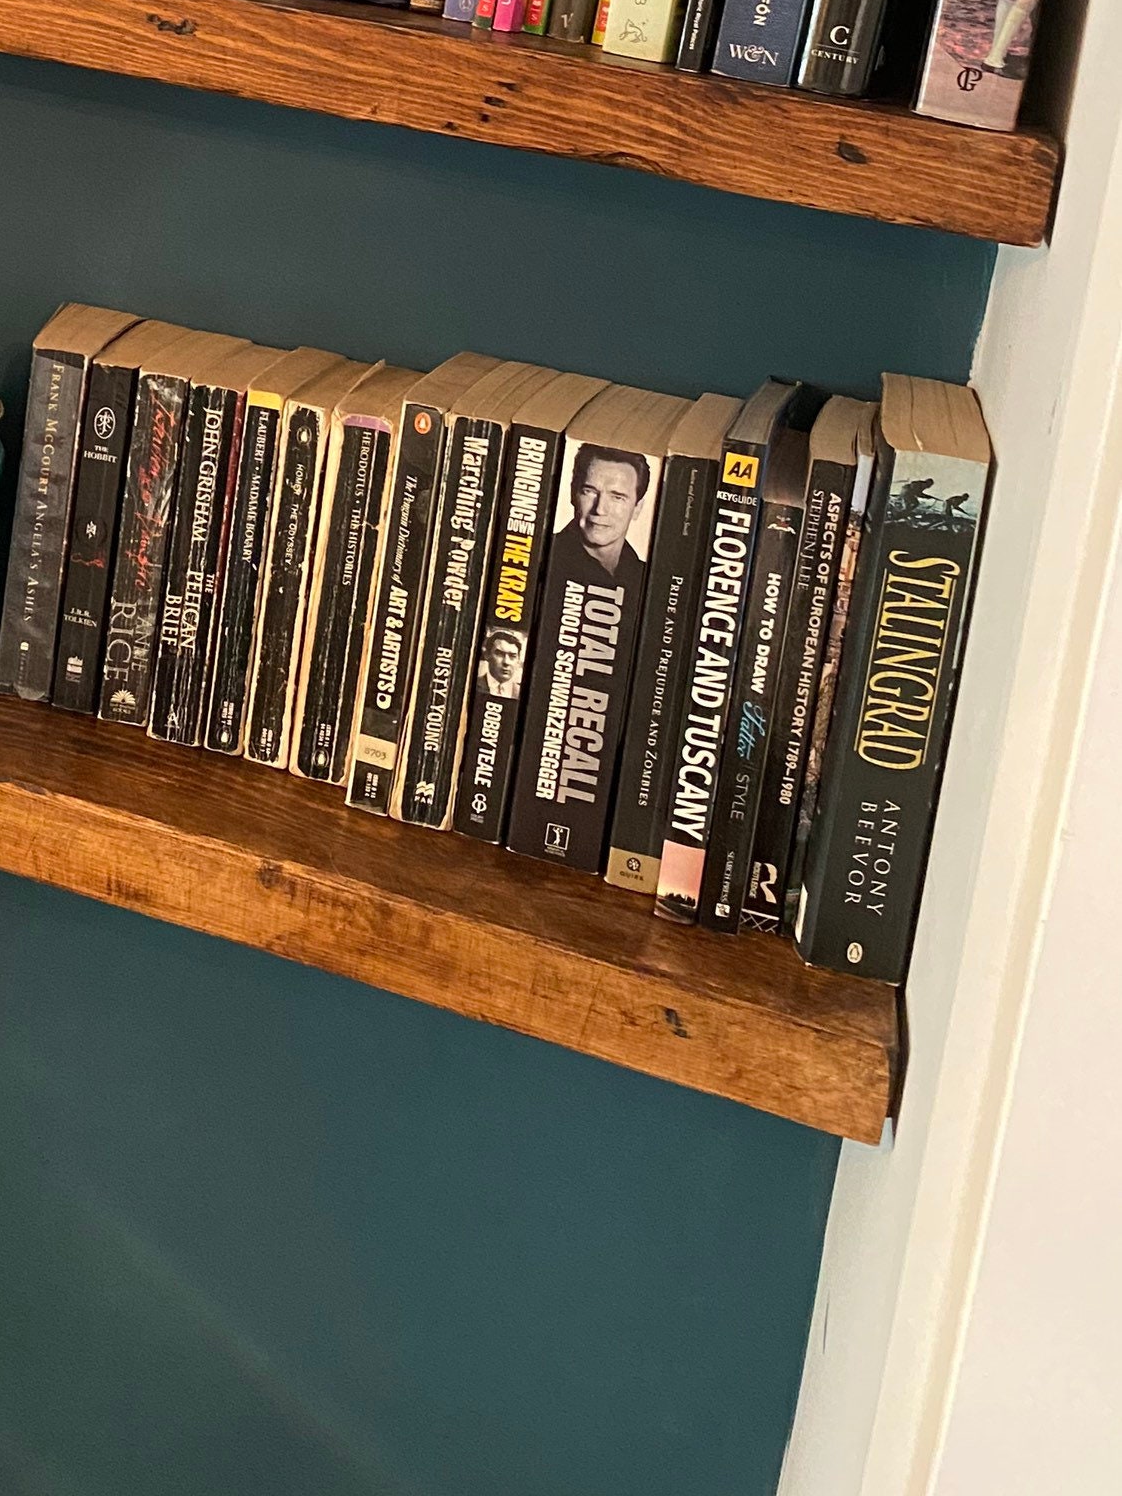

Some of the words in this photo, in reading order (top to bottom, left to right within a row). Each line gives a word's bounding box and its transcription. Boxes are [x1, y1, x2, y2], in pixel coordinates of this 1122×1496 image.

[810, 47, 860, 65] CENTURY
[83, 450, 118, 464] HOBBIT
[202, 406, 225, 458] JOHN
[450, 435, 490, 534] Marching
[507, 435, 548, 525] BRINGING
[716, 489, 758, 506] KEYGUIDE
[727, 461, 754, 480] AA
[191, 460, 217, 543] GRISHAM
[442, 535, 476, 613] Powder
[502, 534, 533, 568] THE
[698, 507, 753, 649] FLORENCE
[161, 592, 183, 648] BRIEF
[494, 565, 529, 623] KRAYS
[557, 579, 585, 648] ARNOLD
[666, 575, 684, 615] PRIDE
[763, 572, 782, 615] HOW
[103, 600, 139, 683] RICE
[575, 584, 626, 677] TOTAL
[662, 616, 676, 645] AND
[758, 618, 775, 641] TO
[430, 646, 453, 697] RUSTY
[651, 648, 674, 717] PREJUDICE
[690, 646, 730, 709] AND
[751, 643, 771, 695] DRAW
[858, 549, 962, 772] STALINGRAD
[423, 700, 448, 753] YOUNG
[480, 700, 504, 750] BOBBY
[535, 649, 576, 801] SCHWARZENEGGER
[556, 685, 610, 804] RECALL
[647, 718, 660, 747] AND
[736, 699, 766, 761] Tattoo
[474, 744, 497, 789] TEALE
[637, 750, 658, 807] ZOMBIES
[671, 712, 722, 843] TUSCANY
[730, 773, 751, 822] STYLE
[843, 800, 878, 907] BEEVOR
[866, 799, 902, 917] ANTONY
